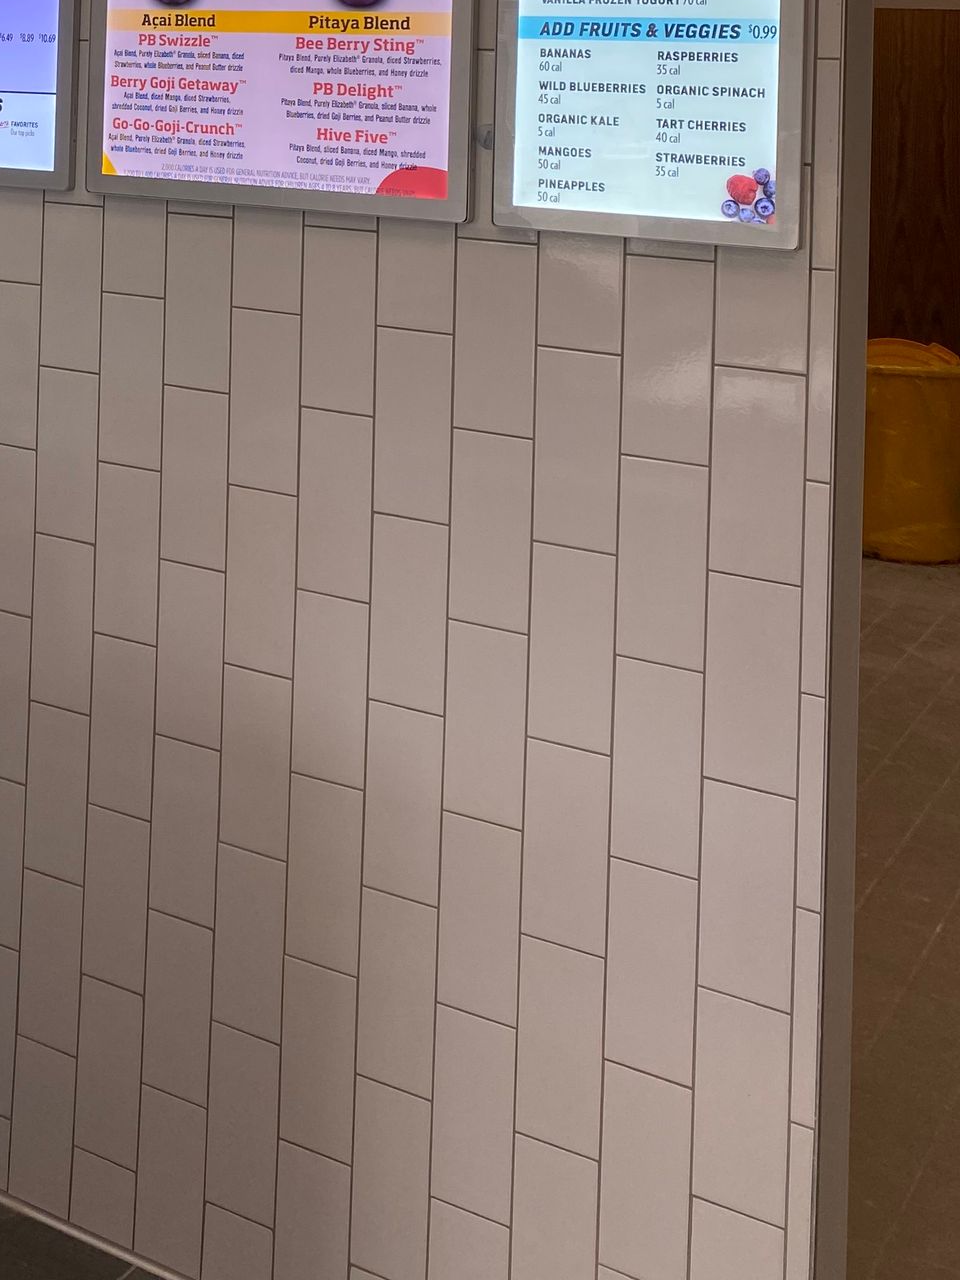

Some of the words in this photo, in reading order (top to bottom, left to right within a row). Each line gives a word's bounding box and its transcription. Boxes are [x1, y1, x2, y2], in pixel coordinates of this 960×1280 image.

[141, 13, 172, 30] Açai
[174, 13, 216, 27] Blend
[308, 15, 360, 32] Pitaya
[363, 15, 411, 31] Blend
[539, 21, 575, 37] ADD
[578, 21, 642, 38] FRUITS
[645, 22, 659, 38] &
[664, 23, 742, 40] VEGGIES
[295, 36, 324, 50] Bee
[326, 37, 371, 55] Berry
[540, 48, 591, 59] BANANAS
[657, 50, 738, 63] RASPBERRIES
[110, 74, 148, 91] Berry
[150, 76, 175, 92] Goji
[538, 80, 567, 91] WILD
[569, 81, 646, 94] BLUEBERRIES
[655, 152, 746, 167] STRAWBERRIES
[538, 178, 605, 192] PINEAPPLES
